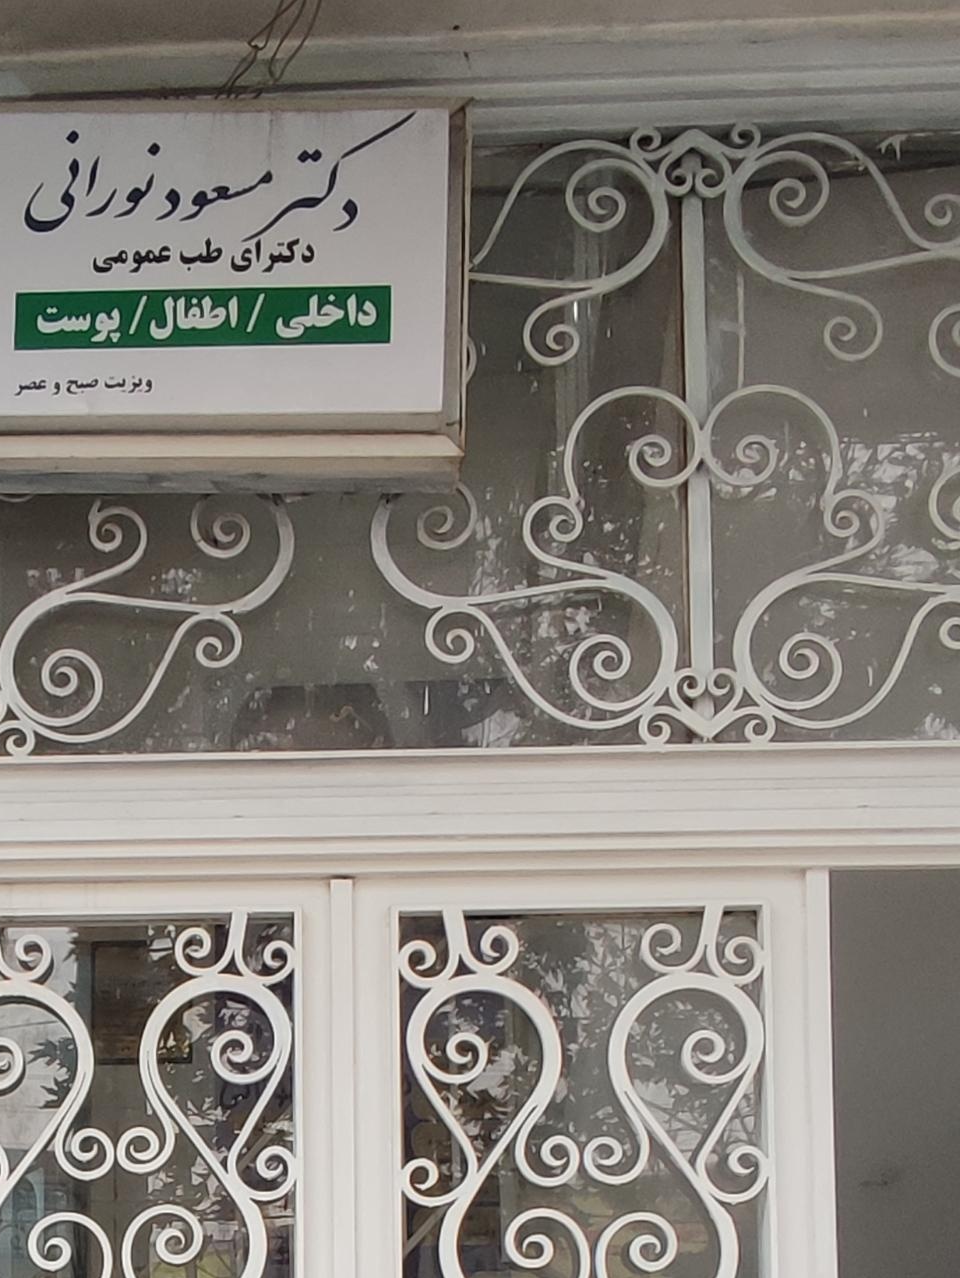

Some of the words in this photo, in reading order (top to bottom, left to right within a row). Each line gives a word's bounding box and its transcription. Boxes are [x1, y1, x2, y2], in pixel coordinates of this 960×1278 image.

[24, 129, 161, 233] نورانی
[241, 110, 417, 243] دکتر
[155, 169, 274, 222] مسعود
[92, 245, 172, 274] عمومی
[178, 237, 224, 272] طب
[230, 237, 316, 273] دکترای
[36, 307, 121, 343] پوست
[149, 295, 239, 341] اطفال
[275, 293, 378, 339] داخلی
[14, 379, 48, 397] عصر
[52, 380, 62, 395] و
[65, 377, 100, 395] صبح
[103, 375, 154, 394] ویزیت
